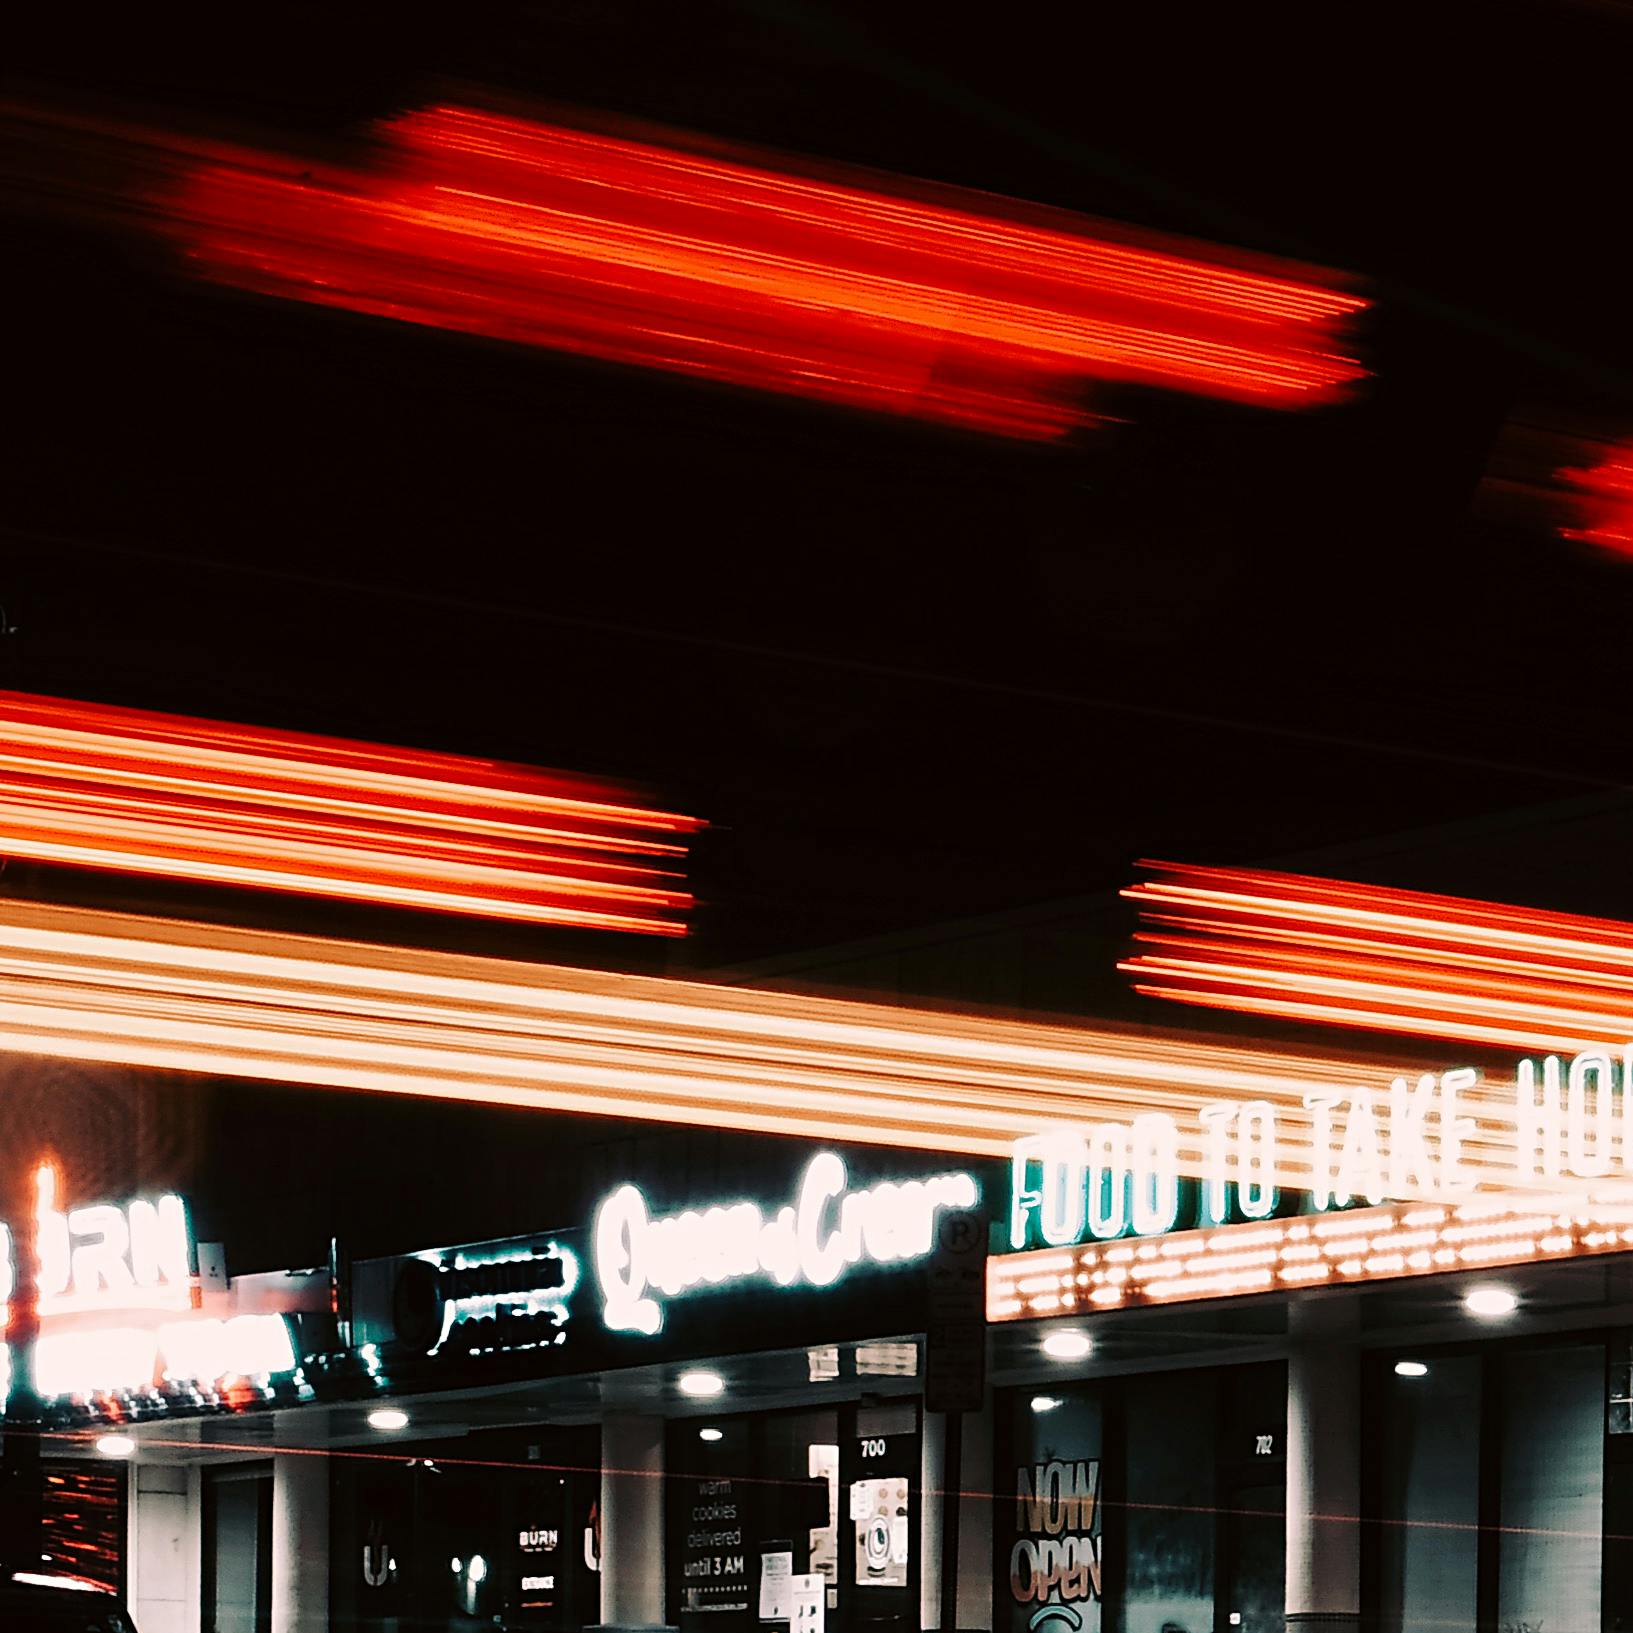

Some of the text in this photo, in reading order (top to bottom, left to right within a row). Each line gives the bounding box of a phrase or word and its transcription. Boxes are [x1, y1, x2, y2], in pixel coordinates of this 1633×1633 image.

[1011, 1112, 1177, 1248] FOOD
[1200, 1102, 1275, 1223] TO
[1304, 1069, 1478, 1210] TAKE
[861, 1440, 886, 1457] 700
[1016, 1460, 1099, 1535] NOW
[693, 1502, 737, 1520] cookies
[713, 1557, 721, 1575] 3
[724, 1556, 744, 1574] AM
